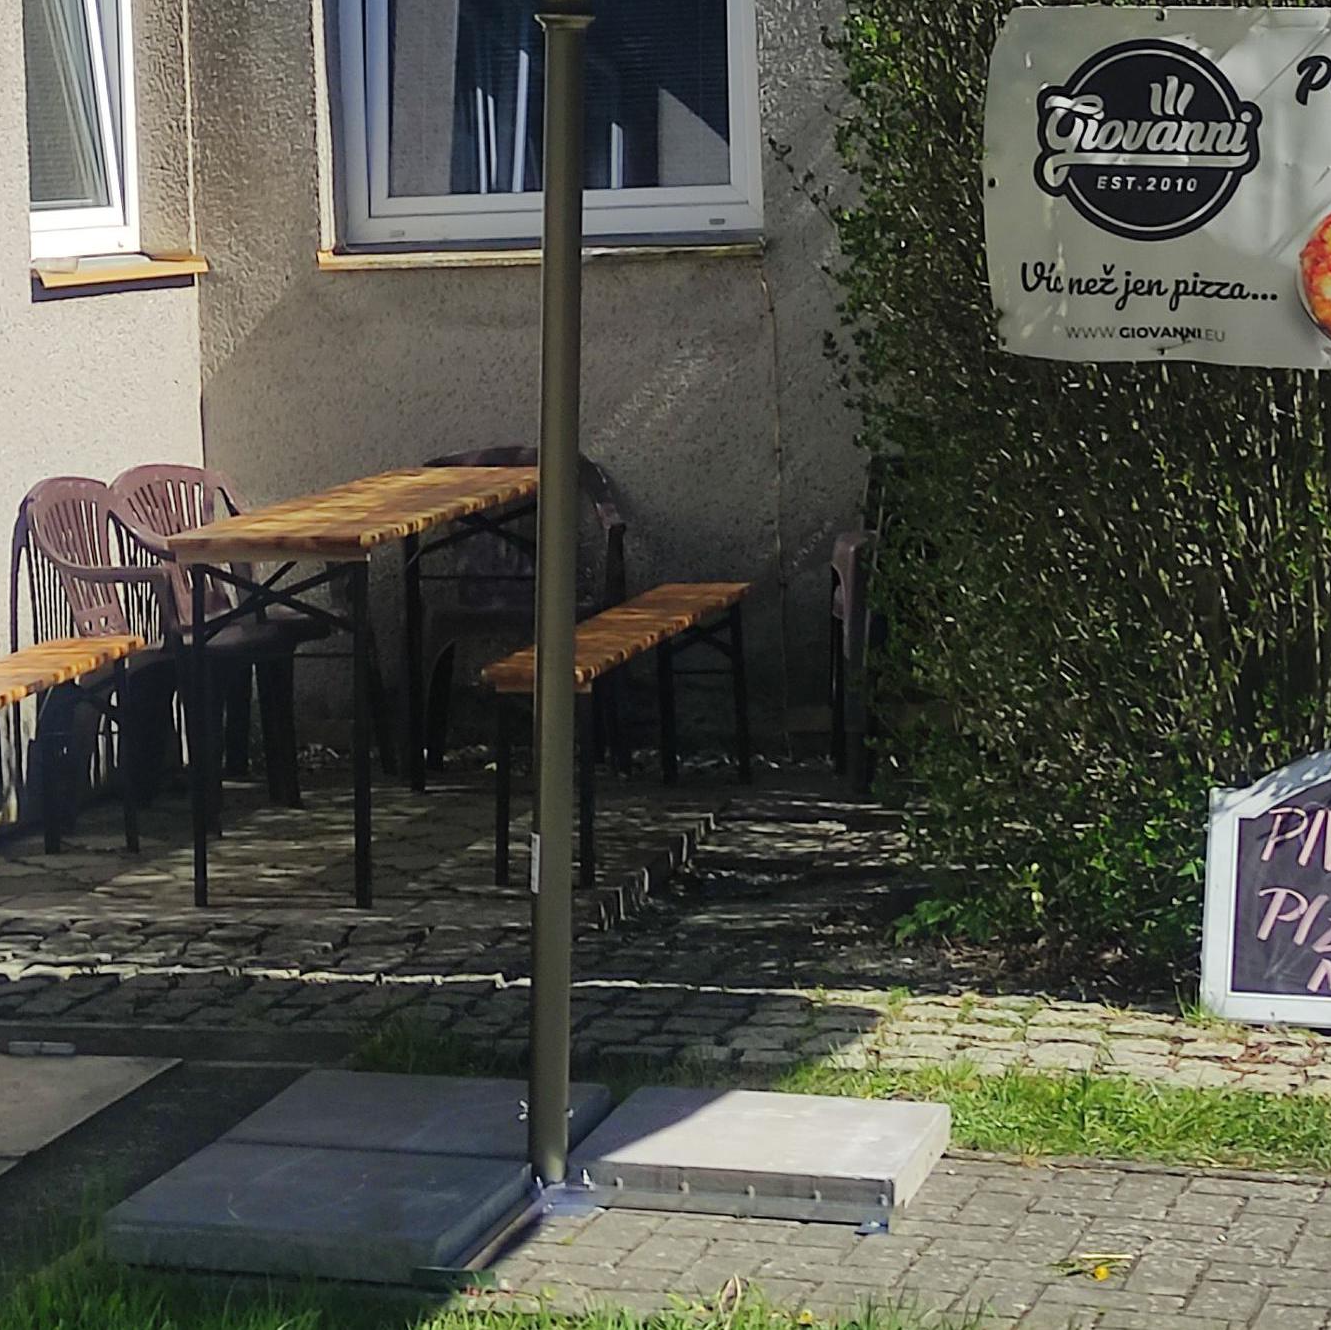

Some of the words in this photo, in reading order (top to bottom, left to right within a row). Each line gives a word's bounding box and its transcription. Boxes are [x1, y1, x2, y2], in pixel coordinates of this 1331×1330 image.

[1044, 94, 1250, 187] Giovanni
[1069, 263, 1117, 296] než
[1115, 271, 1168, 311] jen
[1169, 272, 1278, 311] pizza...
